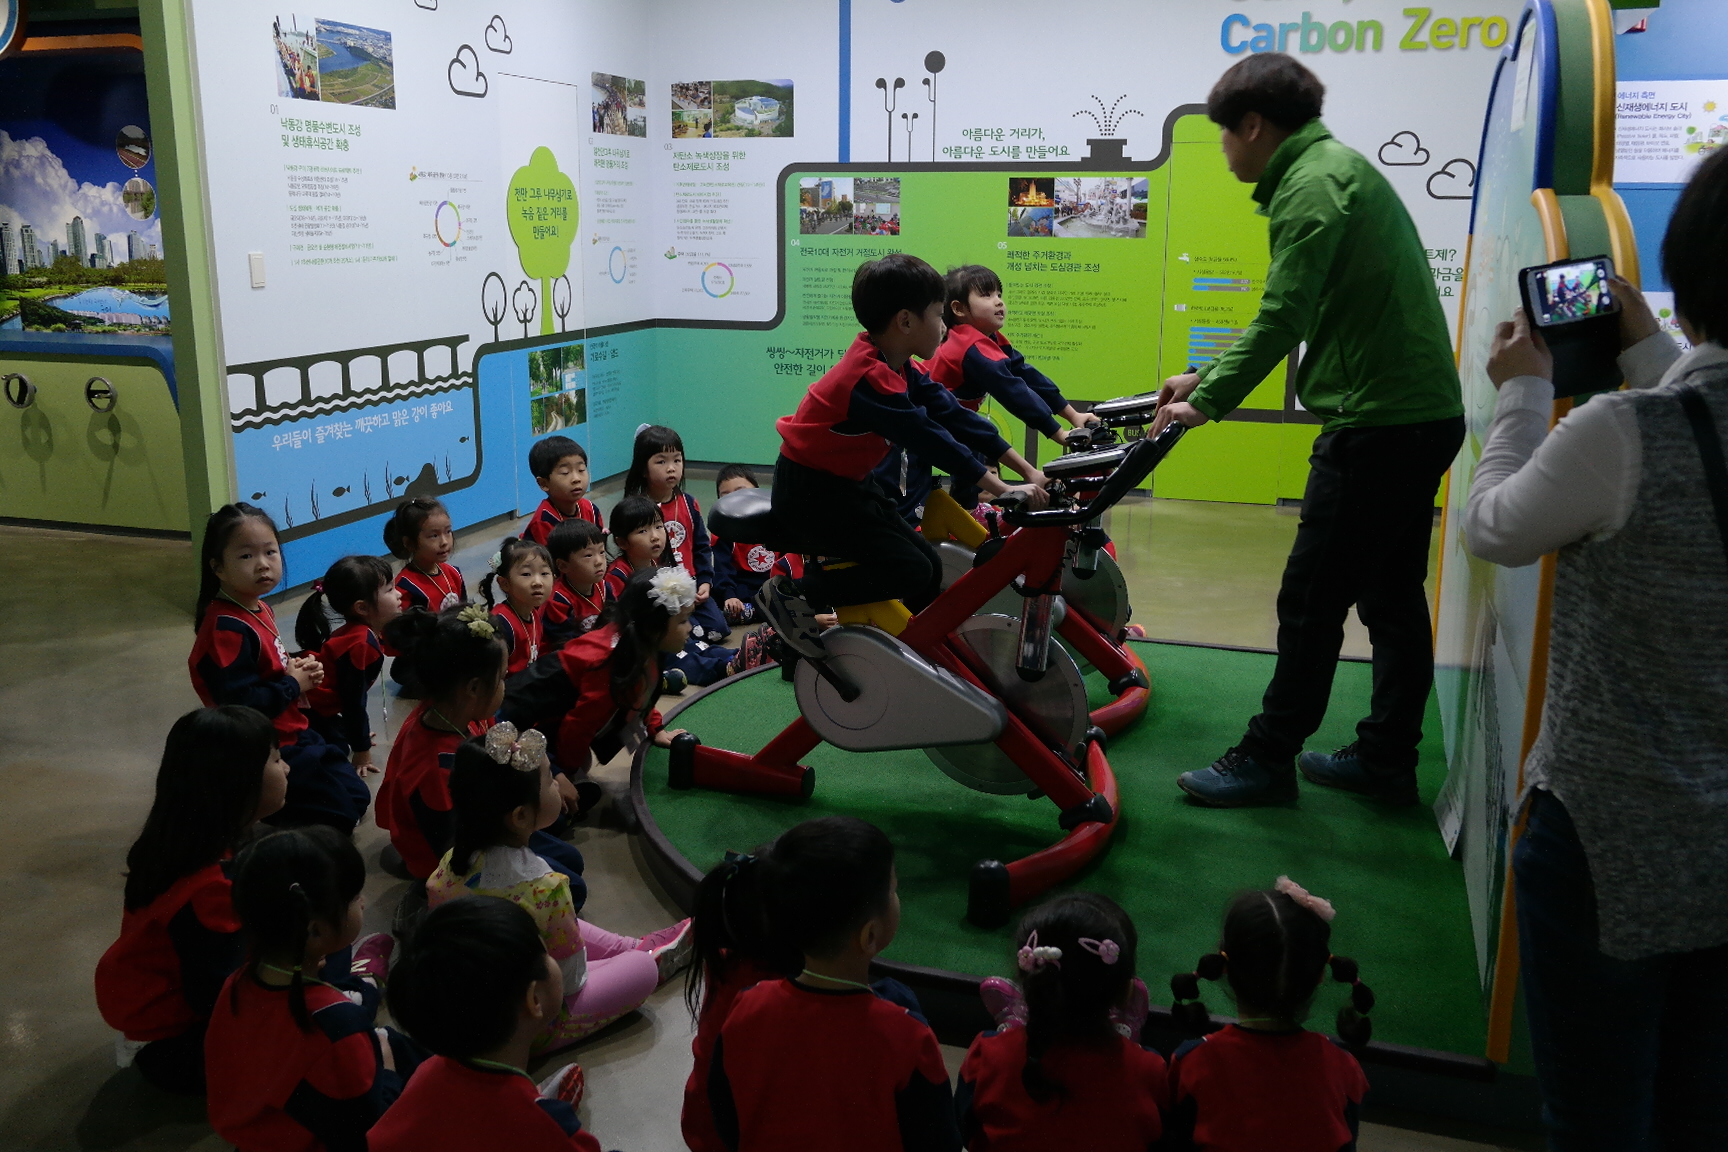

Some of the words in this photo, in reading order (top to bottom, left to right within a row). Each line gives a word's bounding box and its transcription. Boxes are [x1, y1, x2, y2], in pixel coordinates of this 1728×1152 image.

[1220, 11, 1383, 54] Carbon
[1399, 7, 1508, 49] Zero
[1618, 91, 1639, 100] 에너지
[270, 104, 279, 114] 01
[1616, 102, 1667, 112] 신재생에너지
[1670, 102, 1688, 111] 도시
[280, 117, 302, 132] 낙동강
[305, 120, 346, 135] 명품수변도시
[348, 124, 361, 136] 조성
[962, 128, 1005, 142] 아름다운
[1010, 128, 1046, 141] 거리가,
[282, 134, 290, 147] 및
[292, 135, 334, 150] 생태휴식공간
[336, 139, 350, 152] 확충
[695, 151, 730, 160] 녹색성장을
[732, 151, 746, 160] 위한
[942, 146, 985, 159] 아름다운
[988, 146, 1022, 159] 도시를
[1026, 146, 1070, 159] 만들어요
[673, 162, 714, 172] 탄소제로도시
[716, 162, 730, 172] 조성
[515, 187, 528, 202] 천만
[529, 188, 542, 200] 그루
[544, 188, 572, 202] 나무심기로
[522, 206, 534, 220] 녹음
[536, 206, 549, 220] 짙은
[550, 207, 568, 220] 거리를
[533, 225, 559, 240] 만들어요!
[800, 248, 830, 256] 전국10대
[832, 248, 854, 257] 자전거
[856, 248, 884, 258] 거점도시
[1007, 250, 1030, 260] 쾌적한
[1032, 251, 1072, 260] 주거환경과
[1007, 262, 1022, 272] 개성
[1024, 262, 1048, 272] 넘치는
[1050, 263, 1082, 272] 도심경관
[1084, 263, 1100, 272] 조성
[766, 346, 834, 360] 씽씽~자전거가
[774, 362, 803, 376] 안전한
[806, 364, 826, 376] 길이
[272, 428, 312, 451] 우리들이
[315, 422, 353, 444] 즐겨찾는
[355, 414, 390, 434] 깨끗하고
[392, 411, 410, 427] 맑은
[412, 405, 428, 422] 강이
[430, 400, 454, 418] 좋아요
